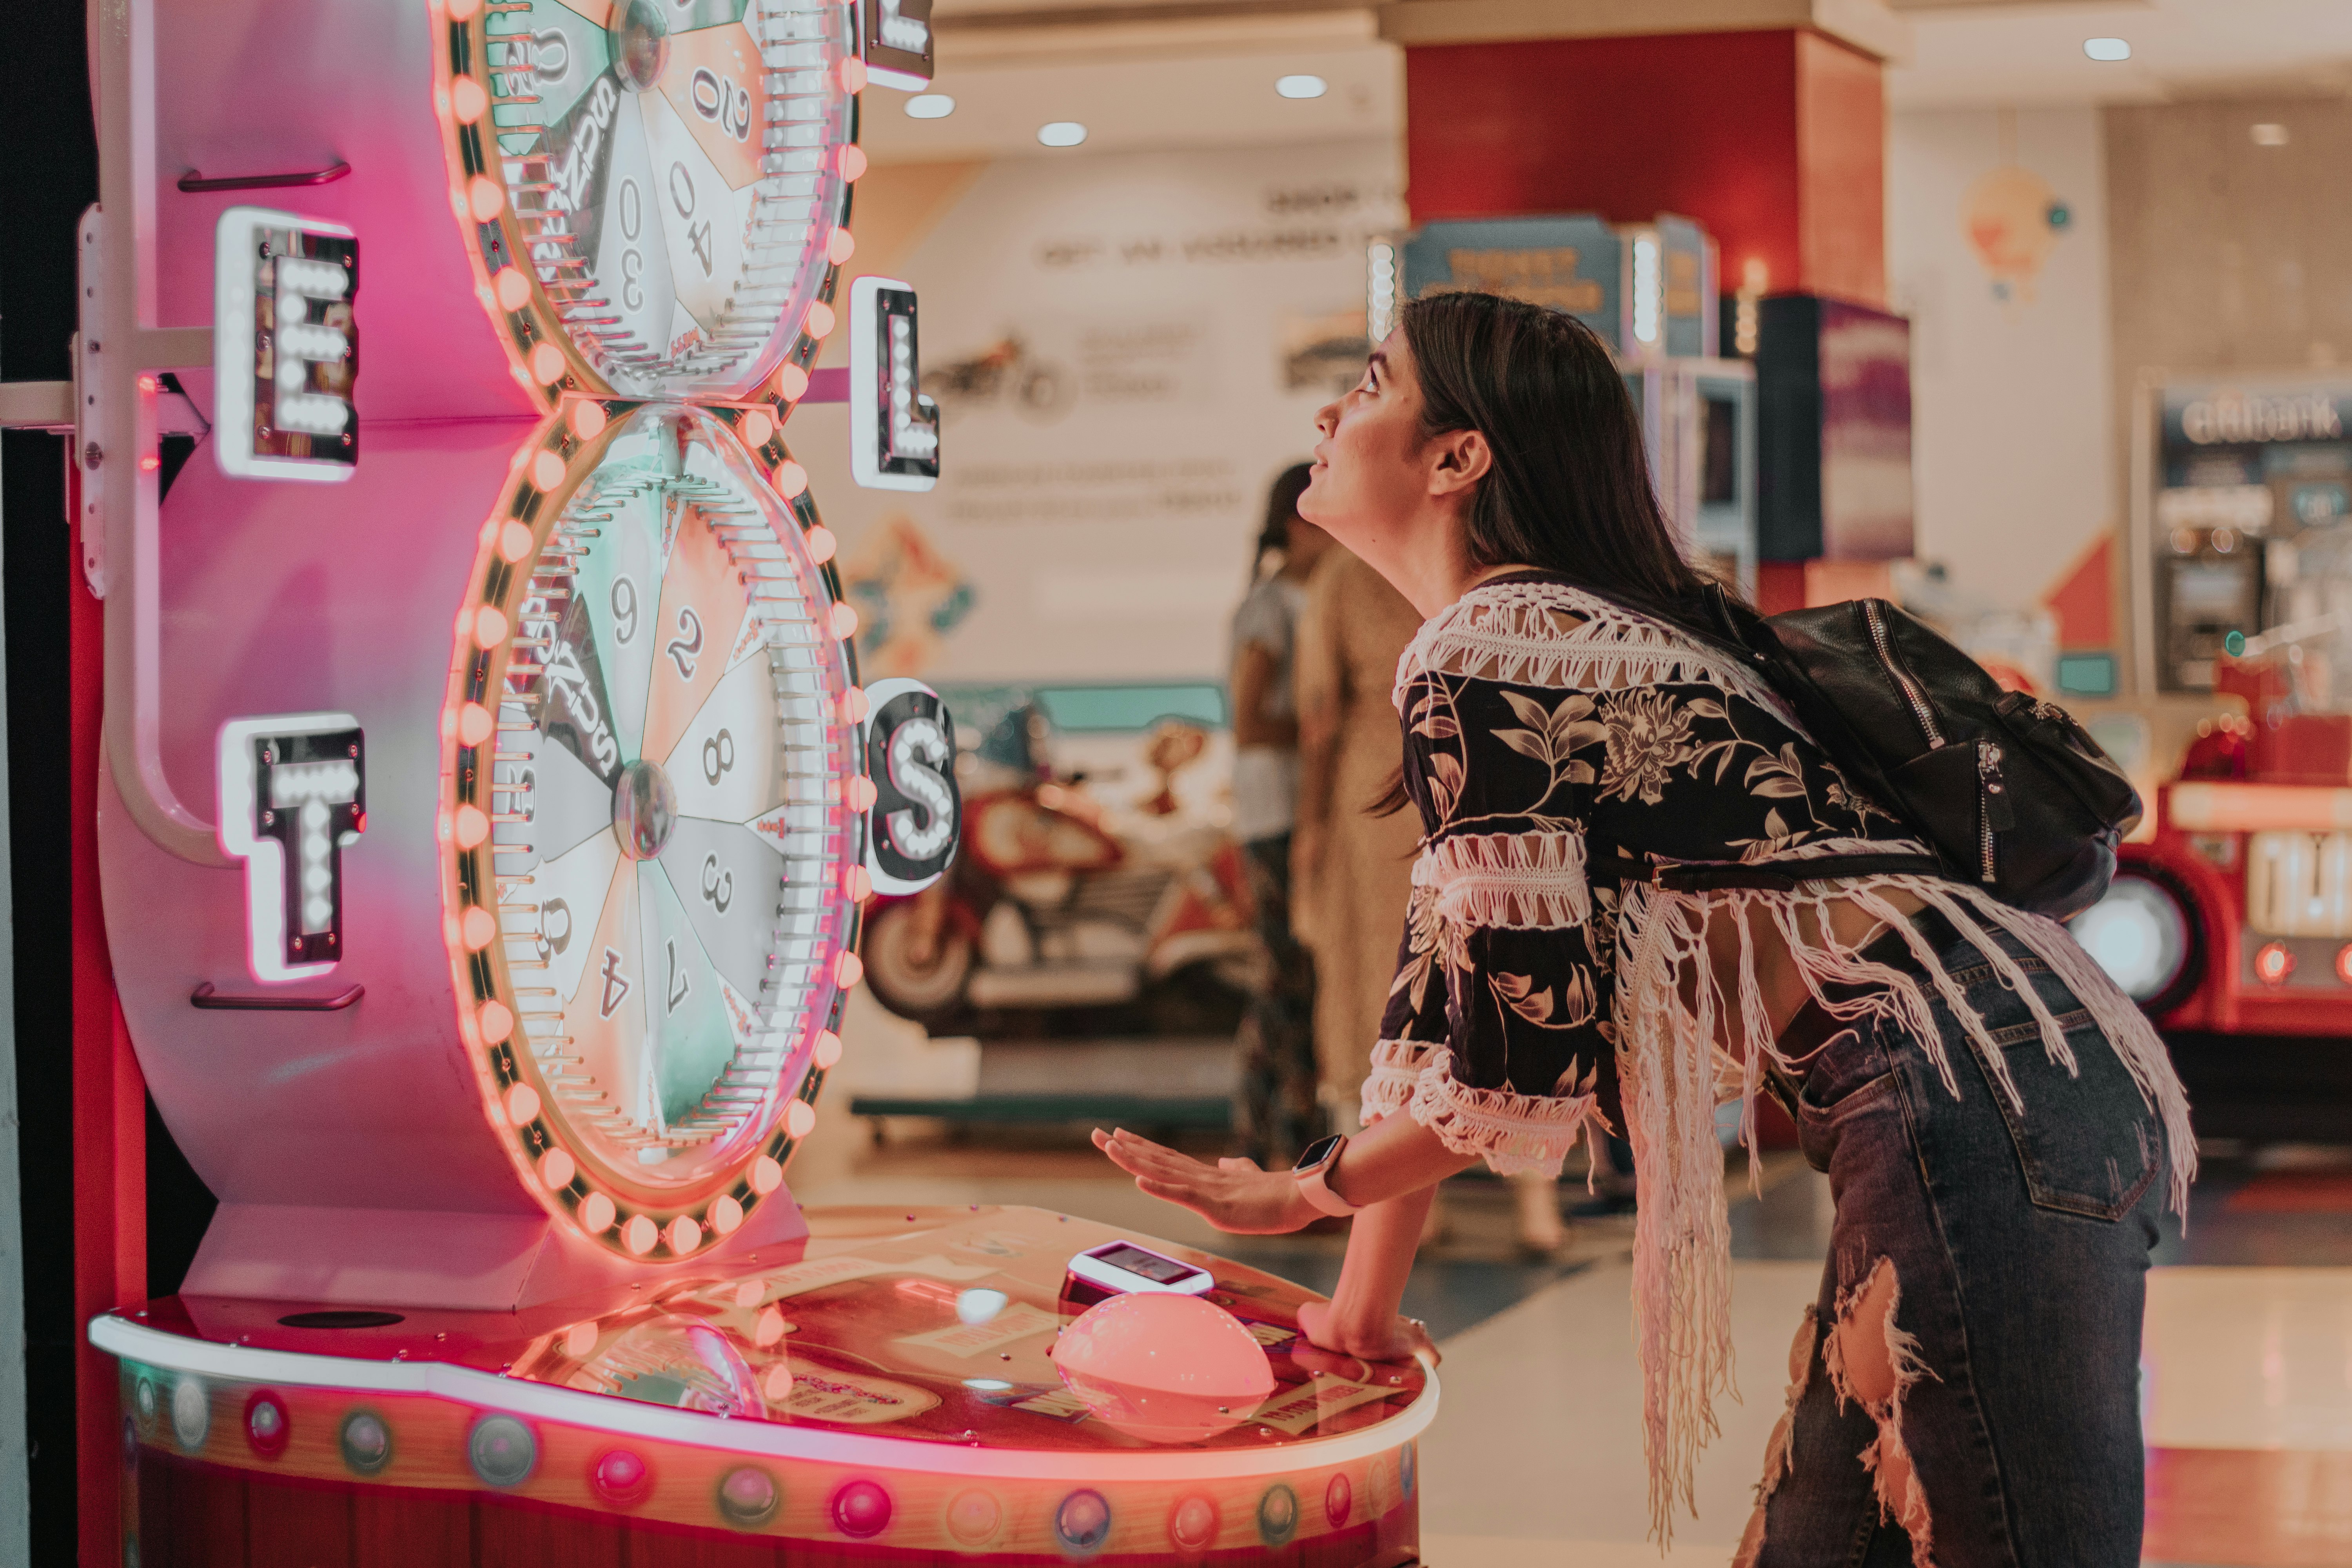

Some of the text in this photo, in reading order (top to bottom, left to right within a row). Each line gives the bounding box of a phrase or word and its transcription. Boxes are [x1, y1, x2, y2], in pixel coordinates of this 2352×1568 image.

[692, 68, 750, 141] 20
[619, 176, 644, 314] 30
[670, 161, 712, 278] 40
[611, 576, 638, 646] 9
[667, 607, 703, 680] 2
[703, 728, 734, 786] 8
[701, 852, 733, 916] 3
[600, 947, 630, 1019] 4
[666, 936, 691, 1017] 7
